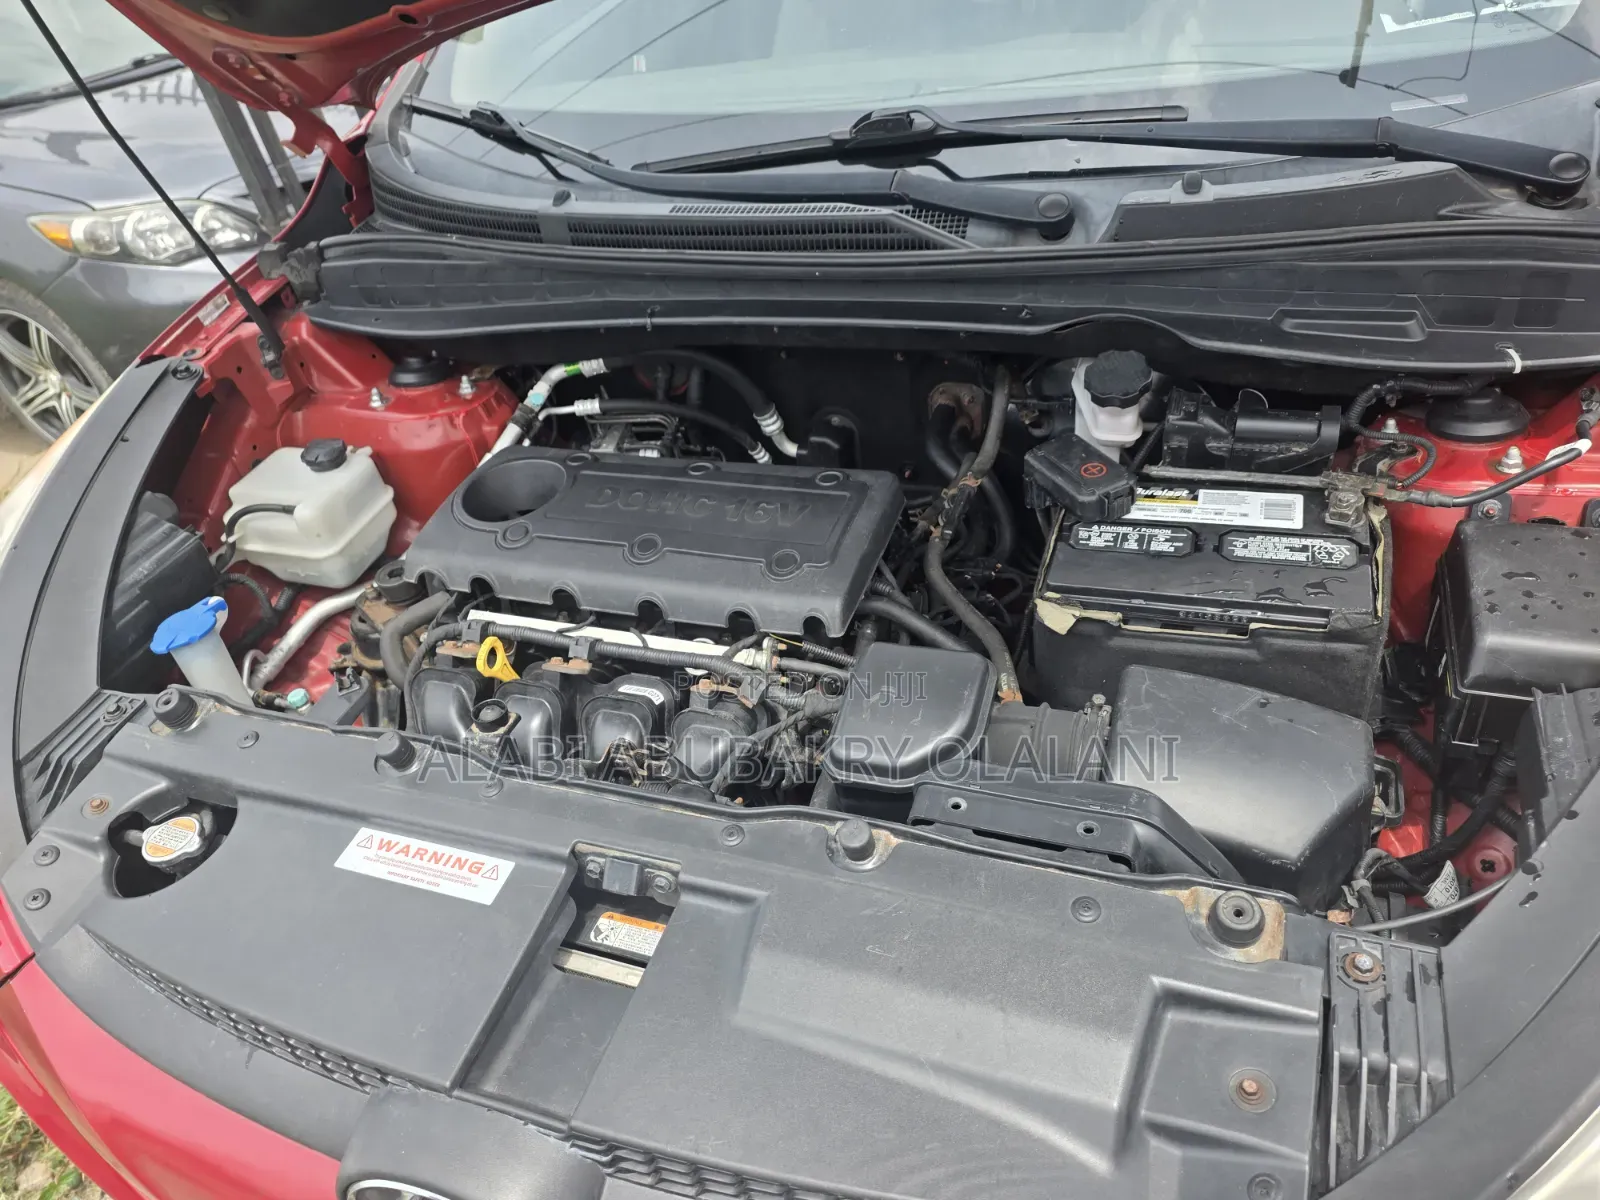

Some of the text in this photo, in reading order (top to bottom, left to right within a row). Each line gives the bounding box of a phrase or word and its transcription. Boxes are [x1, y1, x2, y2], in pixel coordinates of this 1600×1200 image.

[584, 485, 812, 527] DOHC 16V
[1141, 527, 1172, 535] POISON
[377, 838, 486, 875] WARNING
